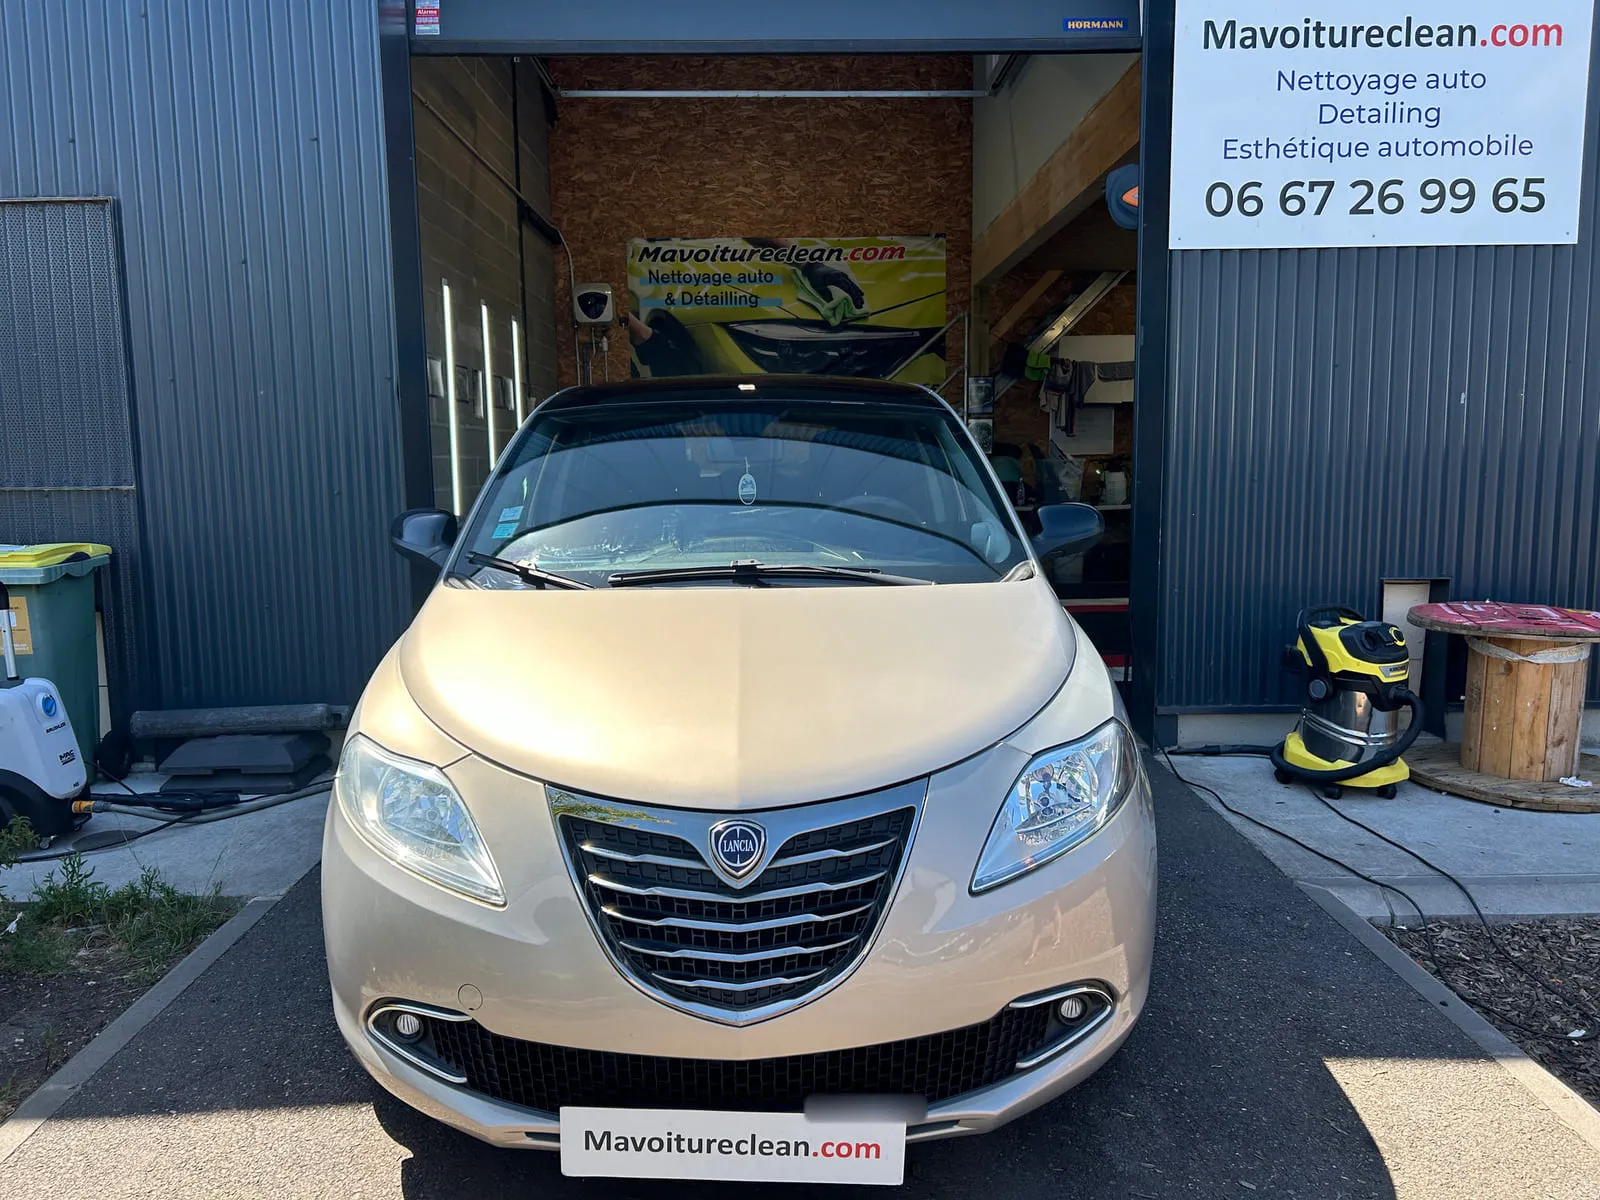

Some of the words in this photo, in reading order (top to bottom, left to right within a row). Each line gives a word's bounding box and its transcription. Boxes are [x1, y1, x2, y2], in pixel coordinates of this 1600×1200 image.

[1202, 16, 1563, 49] Mavoitureclean.com
[1276, 69, 1418, 95] Nettoyage
[1425, 69, 1487, 89] auto
[1318, 101, 1442, 128] Detailing
[1223, 137, 1370, 163] Esthétique
[1378, 134, 1534, 157] automobile
[1205, 181, 1264, 217] 06
[1278, 180, 1335, 216] 67
[1348, 179, 1405, 215] 26
[1419, 178, 1477, 214] 99
[1491, 177, 1547, 213] 65
[638, 244, 906, 263] Mavoitureclean.com
[648, 269, 732, 286] Nettoyage
[737, 270, 774, 283] auto
[664, 293, 676, 306] &
[681, 291, 760, 308] Détailling
[723, 839, 754, 852] LANCIA
[584, 1129, 881, 1159] Mavoitureclean.com
